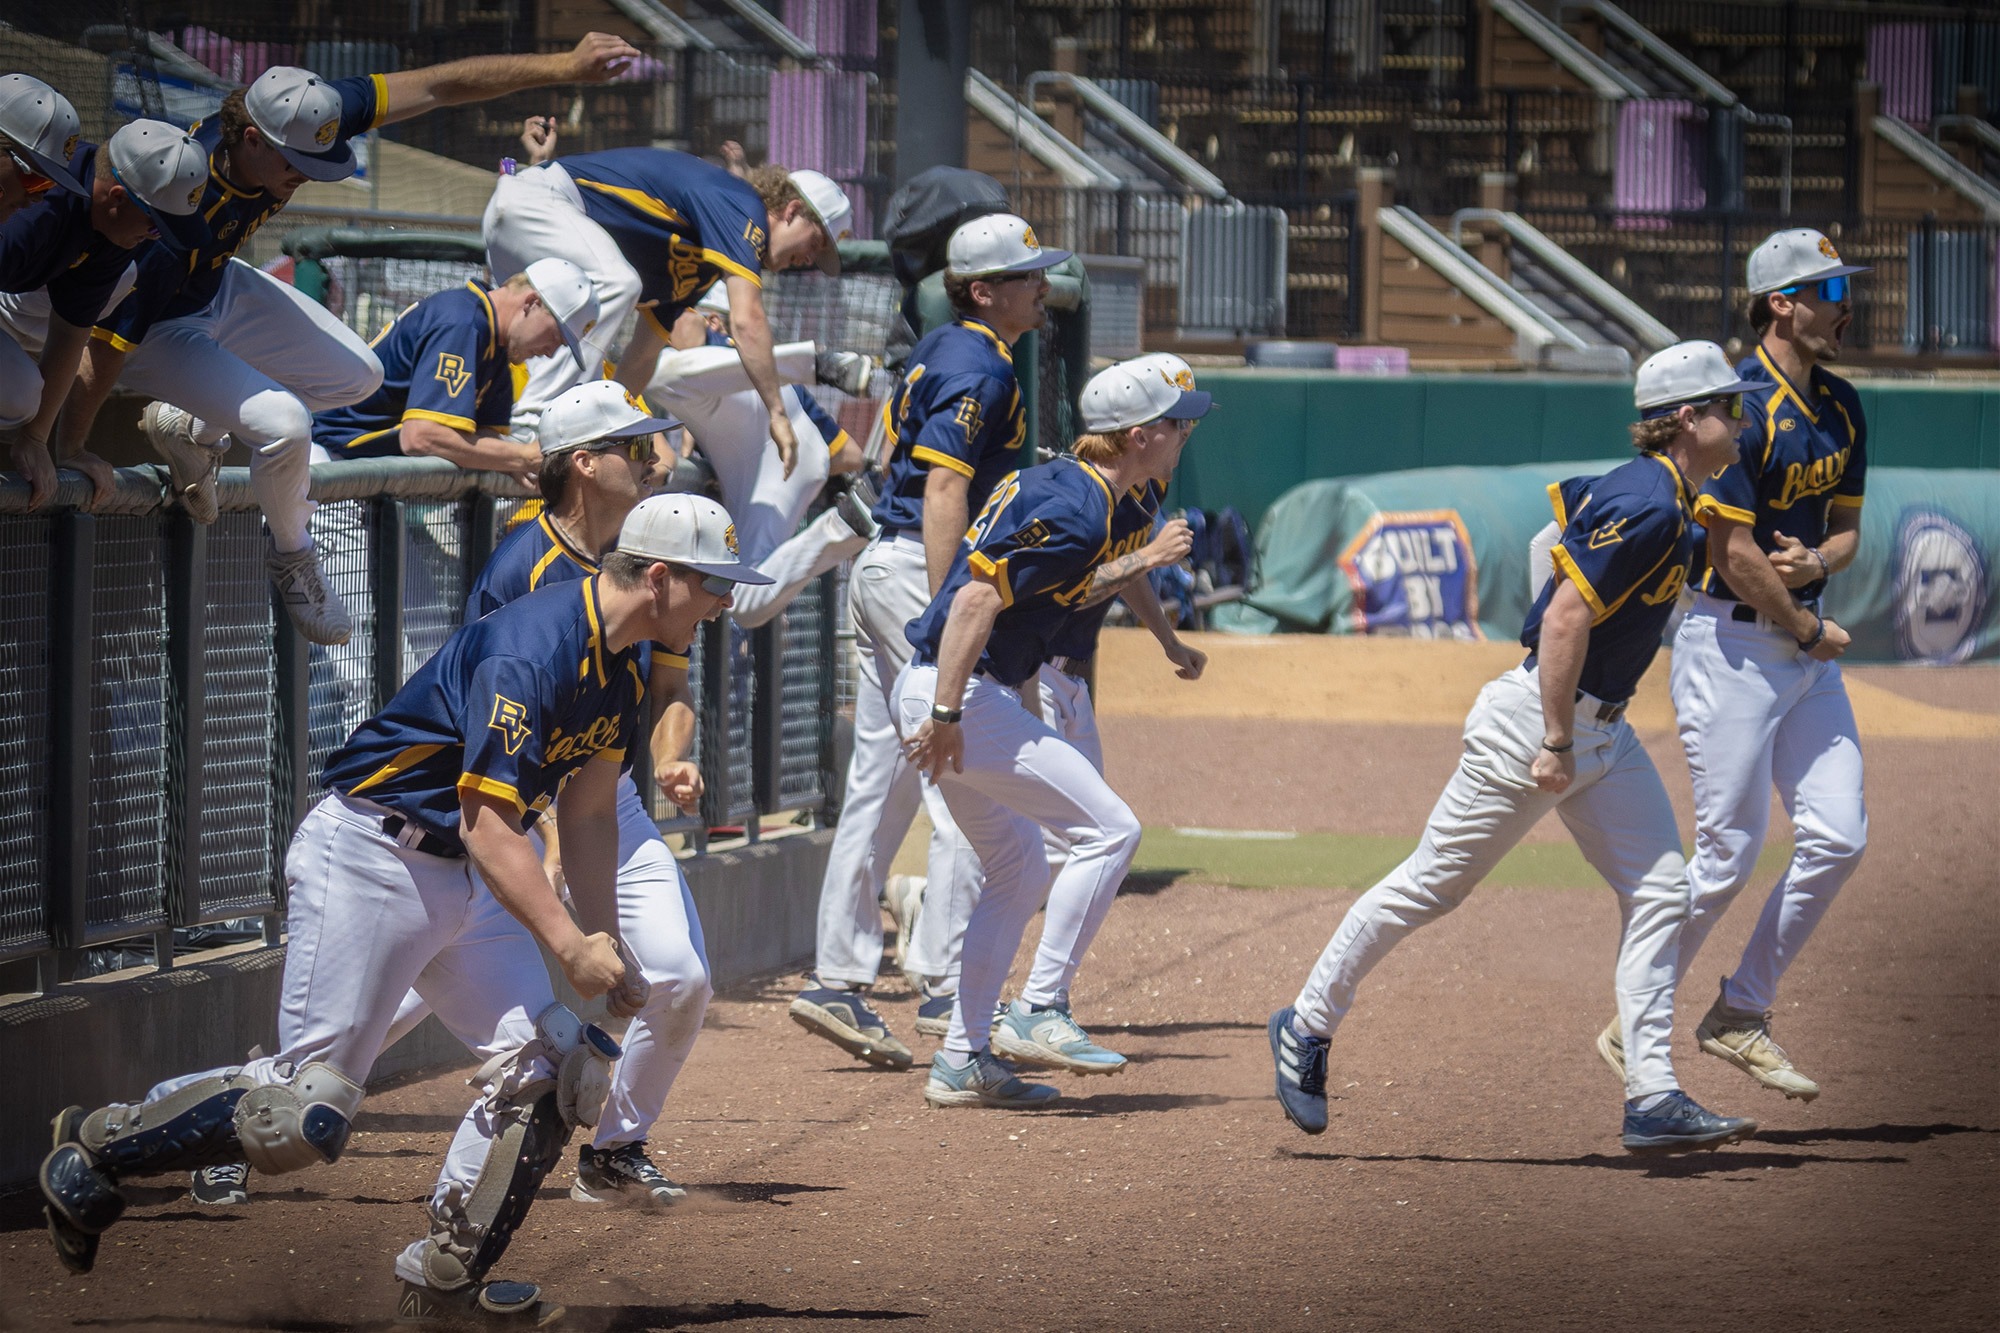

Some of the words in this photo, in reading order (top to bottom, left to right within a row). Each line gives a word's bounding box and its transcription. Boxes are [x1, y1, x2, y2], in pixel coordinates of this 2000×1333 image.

[434, 352, 473, 398] BV
[953, 395, 985, 445] BV
[1360, 527, 1459, 582] BUILT
[1404, 573, 1445, 621] BY
[488, 693, 533, 756] BV
